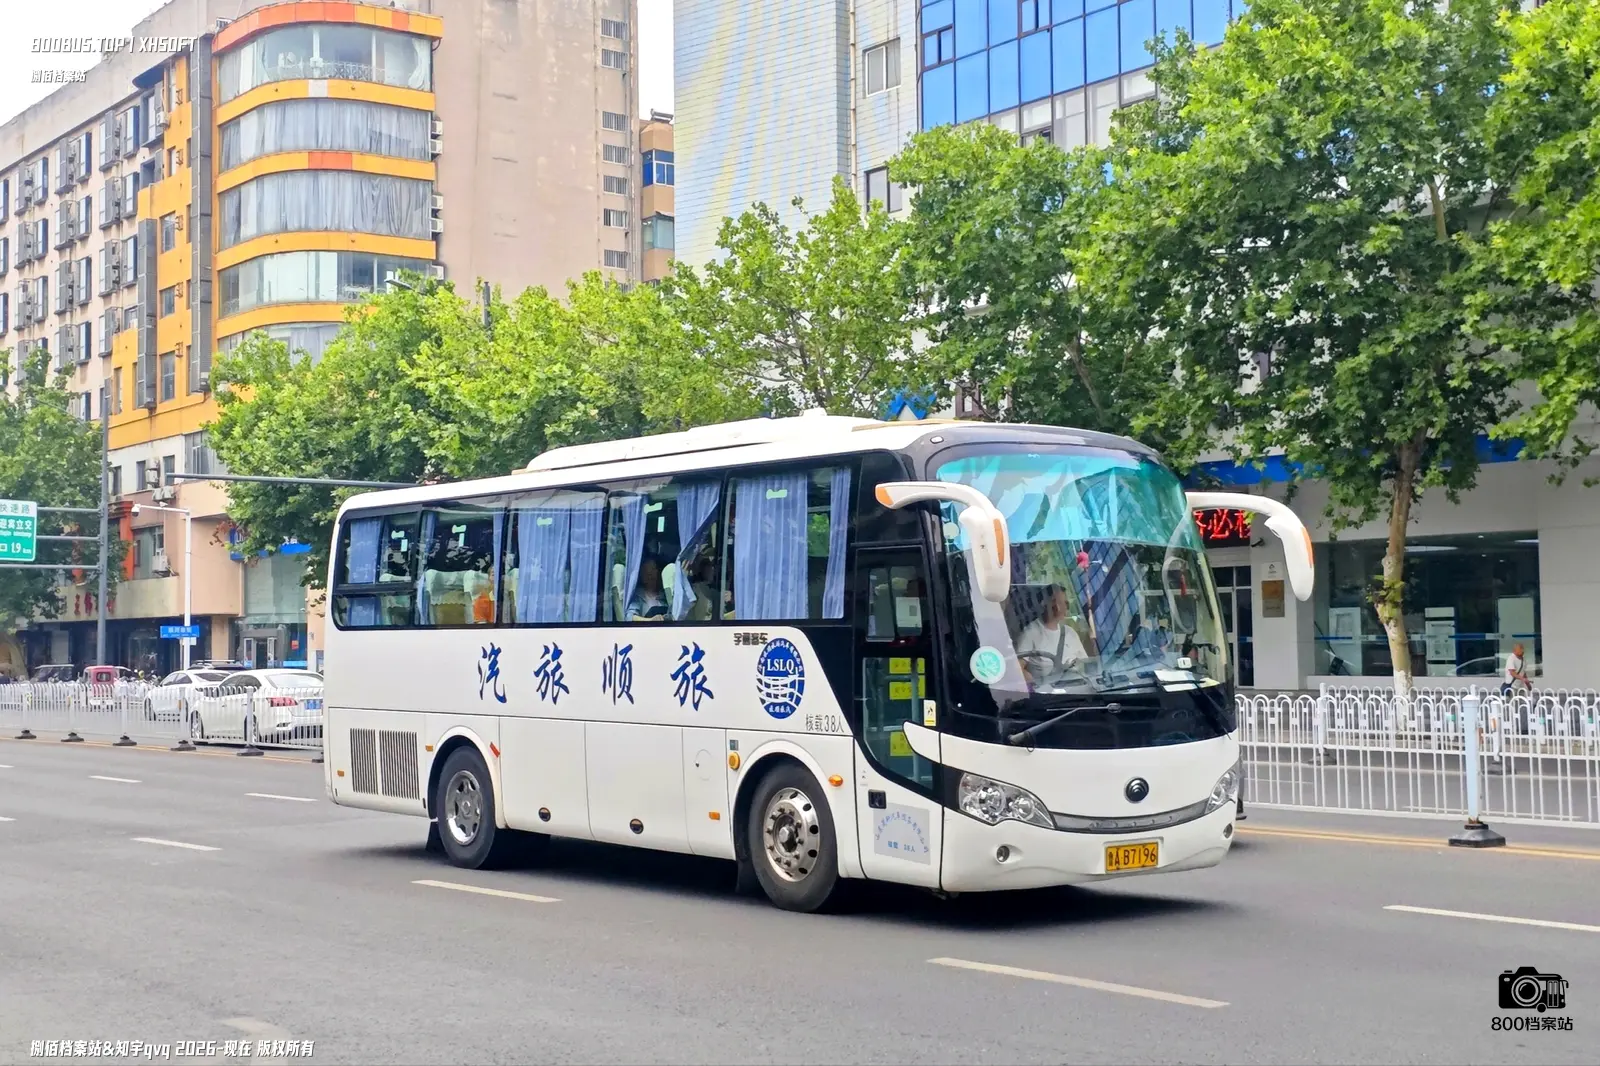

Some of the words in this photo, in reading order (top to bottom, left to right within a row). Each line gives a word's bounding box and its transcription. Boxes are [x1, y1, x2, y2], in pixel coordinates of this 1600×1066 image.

[767, 658, 795, 674] LSLQ
[805, 714, 845, 733] 核载38人
